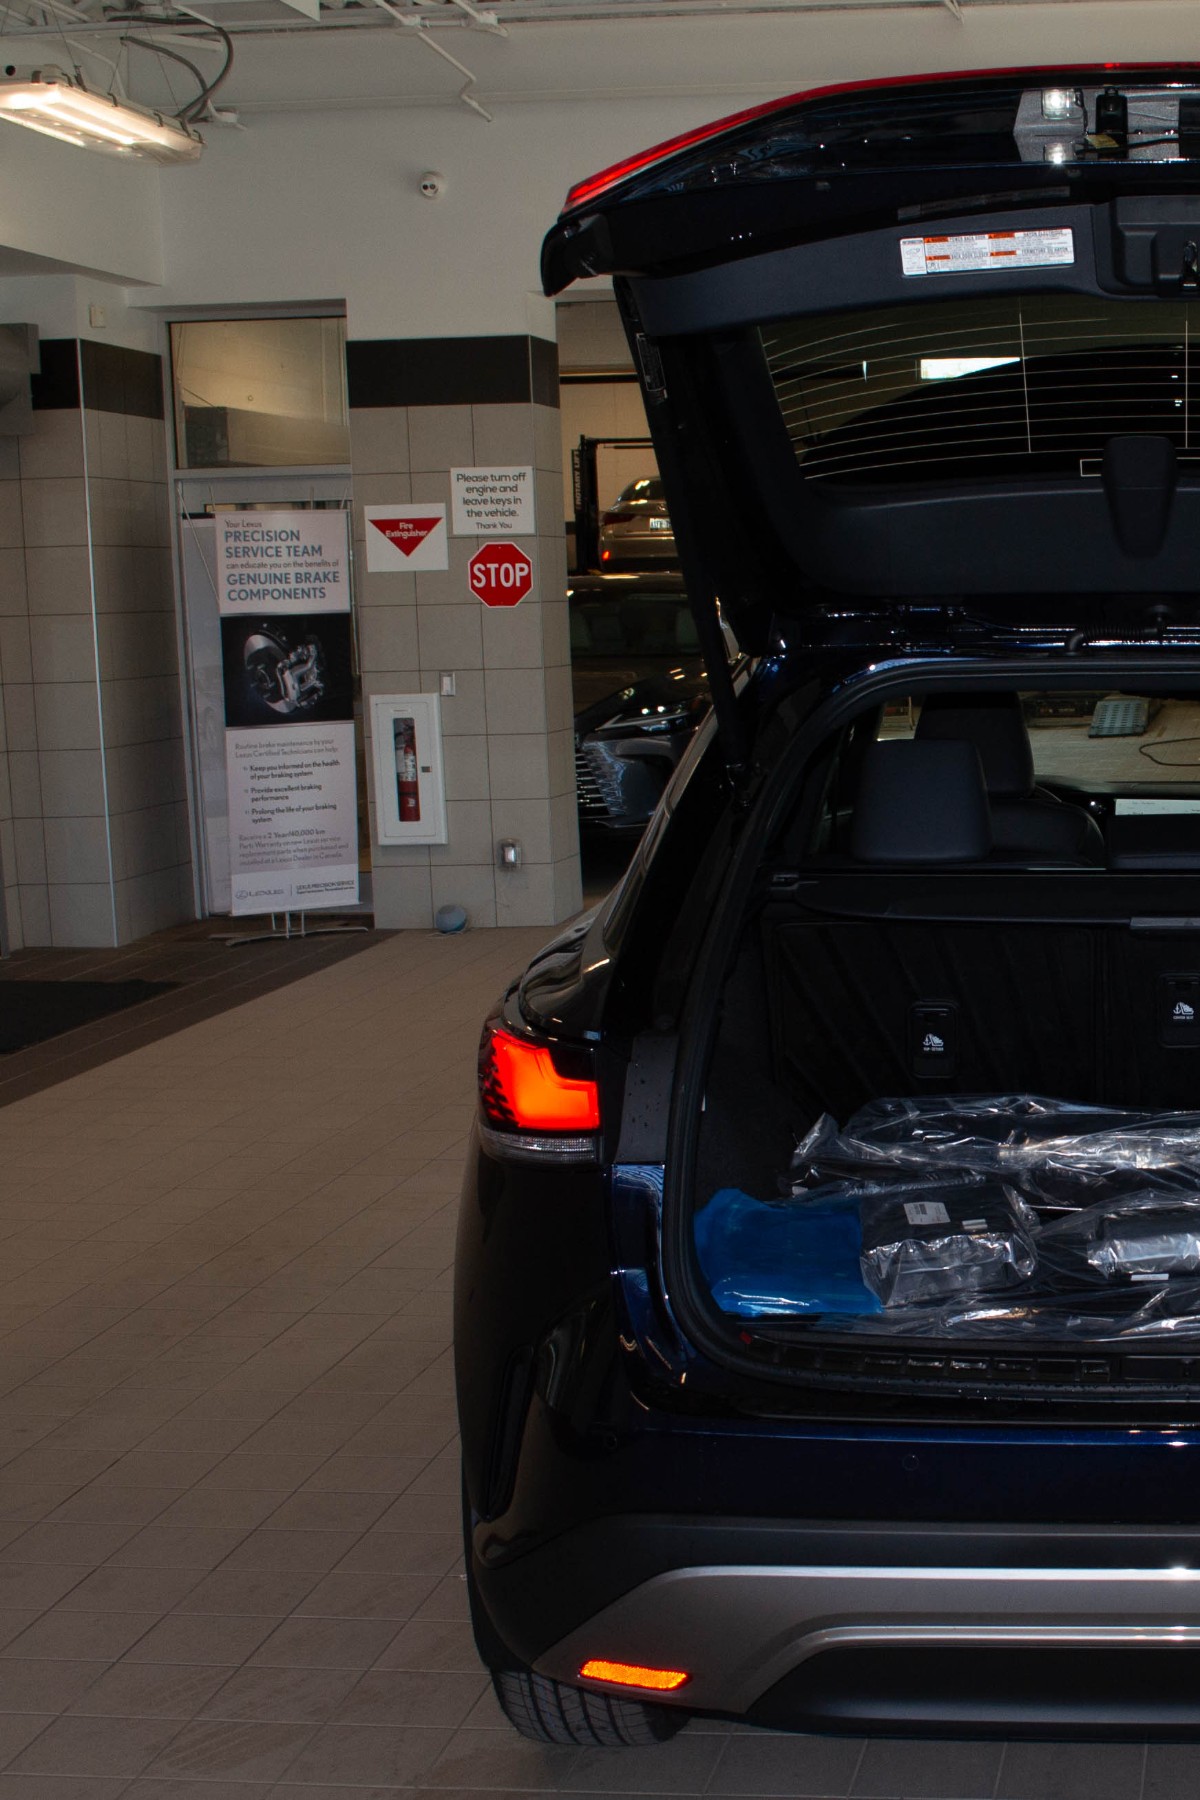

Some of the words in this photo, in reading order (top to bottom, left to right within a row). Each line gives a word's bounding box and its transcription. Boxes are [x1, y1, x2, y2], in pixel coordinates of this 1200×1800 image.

[457, 473, 488, 483] Please
[491, 473, 511, 482] turn
[512, 472, 526, 482] off
[466, 485, 497, 496] engine
[499, 484, 518, 493] and
[462, 497, 489, 506] leave
[490, 497, 512, 506] keys
[513, 497, 522, 505] in
[467, 509, 483, 518] the
[484, 508, 519, 517] vehicle.
[224, 519, 240, 528] Your
[242, 518, 262, 528] Lexus
[399, 522, 413, 530] Fire
[225, 530, 300, 543] PRECISION
[385, 530, 428, 540] Extinguisher
[225, 546, 282, 558] SERVICE
[286, 545, 323, 557] TEAM
[241, 561, 268, 569] educate
[269, 562, 282, 570] you
[332, 559, 339, 567] of
[227, 572, 291, 585] GENUINE
[294, 571, 340, 584] BRAKE
[473, 563, 529, 588] STOP
[228, 587, 326, 601] COMPONENTS
[251, 795, 289, 803] performance
